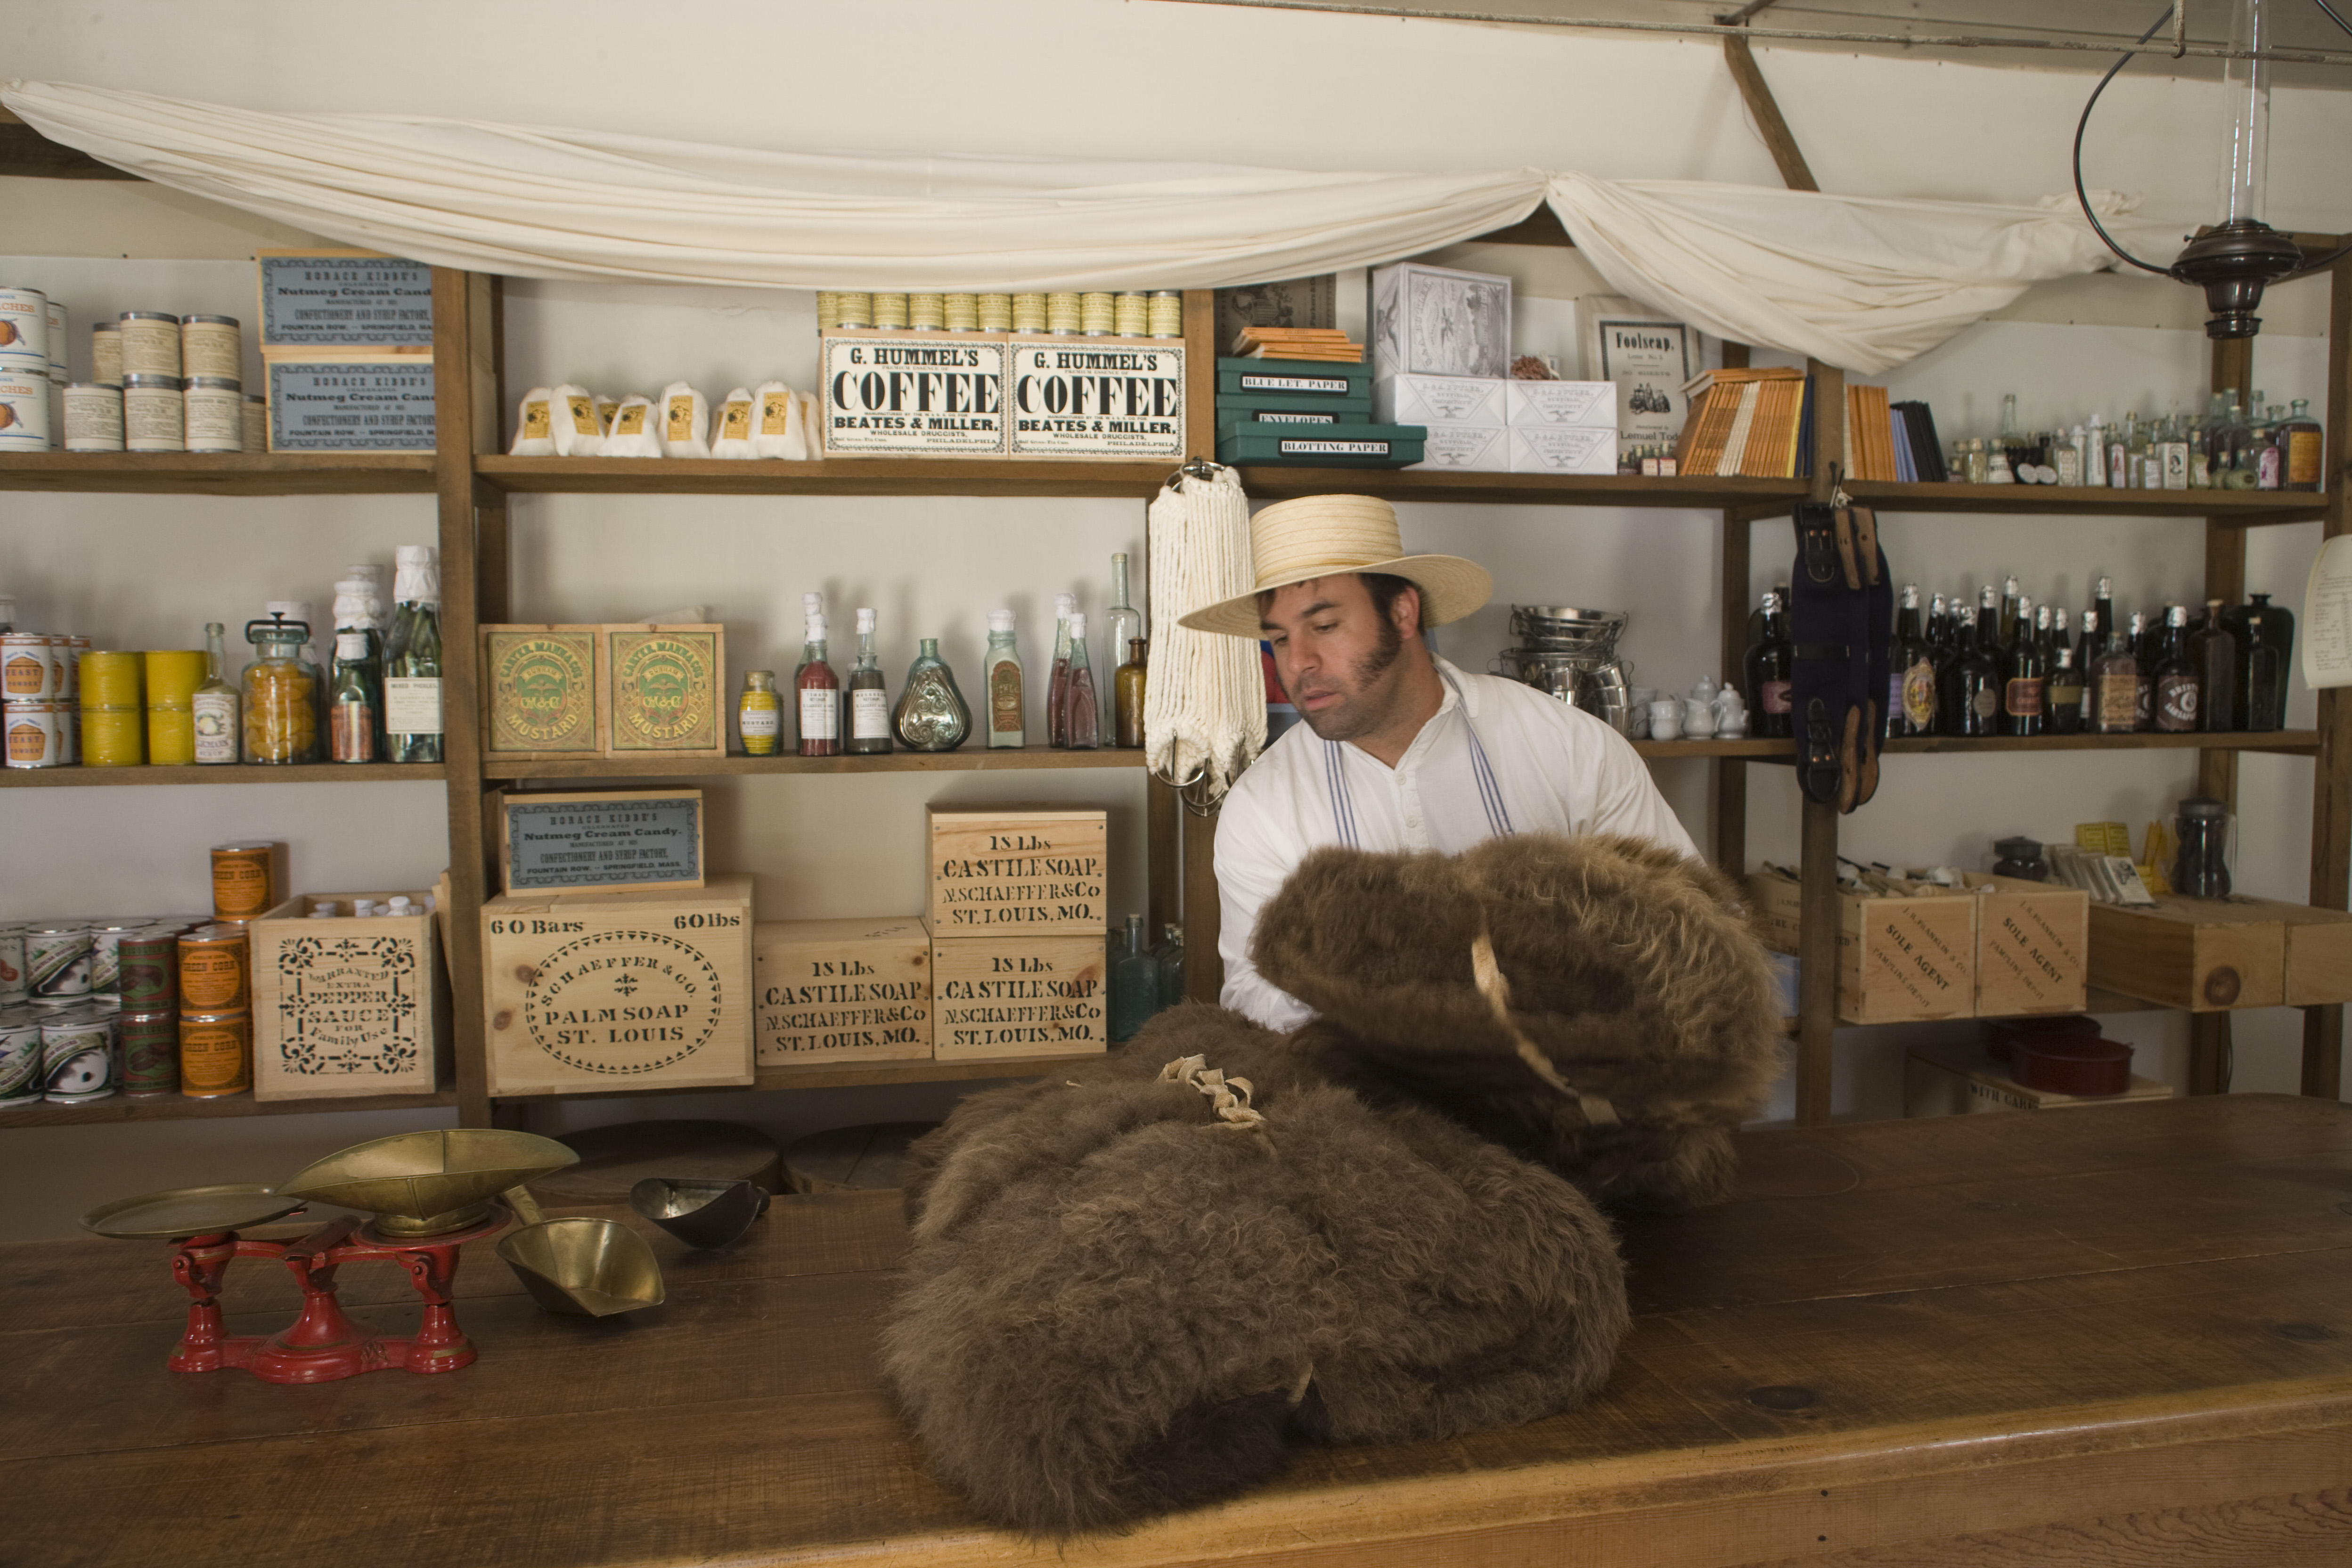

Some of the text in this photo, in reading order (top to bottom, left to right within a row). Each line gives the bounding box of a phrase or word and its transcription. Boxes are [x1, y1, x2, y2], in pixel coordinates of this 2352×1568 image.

[305, 271, 358, 281] HORACE
[278, 287, 337, 297] Nutmeg
[294, 309, 353, 320] CONFECTIONERY
[356, 309, 371, 320] AND
[373, 309, 397, 320] SYRUP
[1616, 332, 1674, 351] Foolscap.
[850, 347, 979, 367] G. HUMMEL'S
[1034, 351, 1157, 371] G. HUMMEL'S
[313, 377, 366, 386] HORACE
[1245, 377, 1346, 390] BLUE LET. PAPER
[286, 393, 346, 403] Nutmeg
[833, 370, 999, 414] COFFEE
[1017, 374, 1177, 416] COFFEE
[302, 415, 361, 425] CONFECTIONERY
[363, 415, 378, 425] AND
[833, 416, 999, 432] BEATES & MILLER,
[1261, 414, 1331, 424] ENVELOPES
[1018, 420, 1176, 435] BEATES & MILLER,
[1620, 431, 1657, 440] Lemuel
[1284, 442, 1386, 452] BLOTTING PAPER
[525, 666, 557, 676] DURHAM
[648, 666, 679, 676] DURHAM
[506, 713, 578, 741] MUSTARD
[628, 712, 698, 739] MUSTARD
[550, 813, 658, 825] HORACE KIBBE'S
[523, 827, 683, 841] Nutmeg Cream Candy.
[1017, 835, 1051, 850] Lbs
[540, 848, 669, 863] CONFECTIONERY AND SYRUP FACTORY,
[239, 869, 261, 879] CORN
[943, 858, 1097, 878] CASTILE SOAP
[1056, 903, 1094, 920] MO.
[531, 919, 584, 934] Bars
[2033, 913, 2064, 948] FRANKLIN
[1917, 919, 1950, 955] FRANKLIN
[1886, 924, 1950, 990] SOLE AGENT
[2002, 917, 2063, 983] SOLE AGENT
[212, 960, 235, 971] CORN
[840, 961, 875, 976] Lbs
[1019, 957, 1053, 972] Lbs
[541, 956, 696, 1007] SCHAEFFER & CO.
[2023, 976, 2045, 1000] DEPOT
[765, 981, 921, 1005] CASTILE SOAP
[945, 980, 1097, 999] CASTILE SOAP
[1906, 983, 1931, 1008] DEPOT
[309, 991, 387, 1004] PEPPER
[308, 1009, 389, 1023] SAUCE
[545, 1004, 689, 1025] PALM SOAP
[309, 1027, 387, 1048] Family Use
[557, 1027, 684, 1045] ST. LOUIS
[882, 1027, 920, 1045] MO.
[1057, 1024, 1094, 1041] MO.
[214, 1039, 236, 1051] CORN
[1970, 1083, 2000, 1102] WITH
